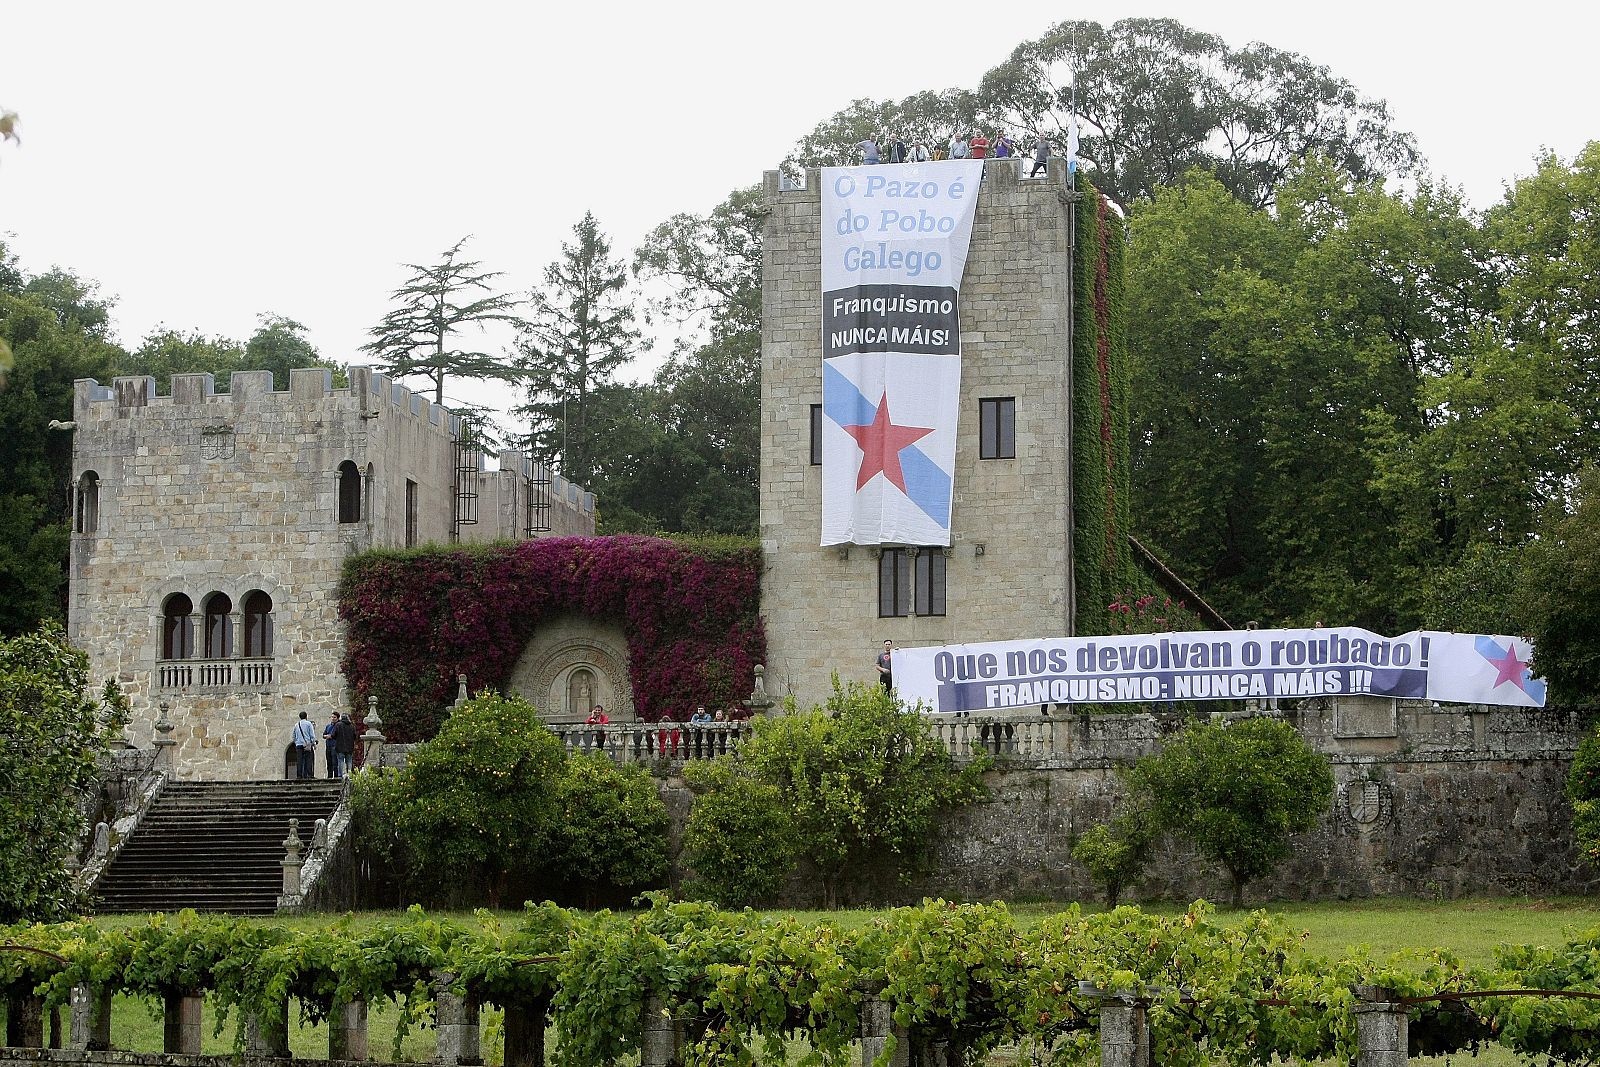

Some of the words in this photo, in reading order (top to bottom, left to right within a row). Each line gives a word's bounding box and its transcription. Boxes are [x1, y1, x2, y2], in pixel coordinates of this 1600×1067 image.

[835, 175, 856, 198] O
[864, 175, 939, 199] Pazo
[947, 176, 965, 200] é
[836, 208, 869, 236] do
[878, 209, 955, 233] Pobo
[843, 243, 942, 277] Galego
[833, 294, 953, 318] Franquismo
[831, 327, 888, 349] NUNCA
[891, 325, 950, 346] MÁIS!
[934, 651, 998, 684] Que
[1006, 648, 1067, 677] nos
[1076, 638, 1232, 673] devolvan
[1241, 640, 1261, 666] o
[1270, 633, 1412, 668] roubado
[985, 676, 1168, 708] FRANQUISMO:
[1174, 674, 1266, 698] NUNCA
[1273, 667, 1342, 695] MÁIS
